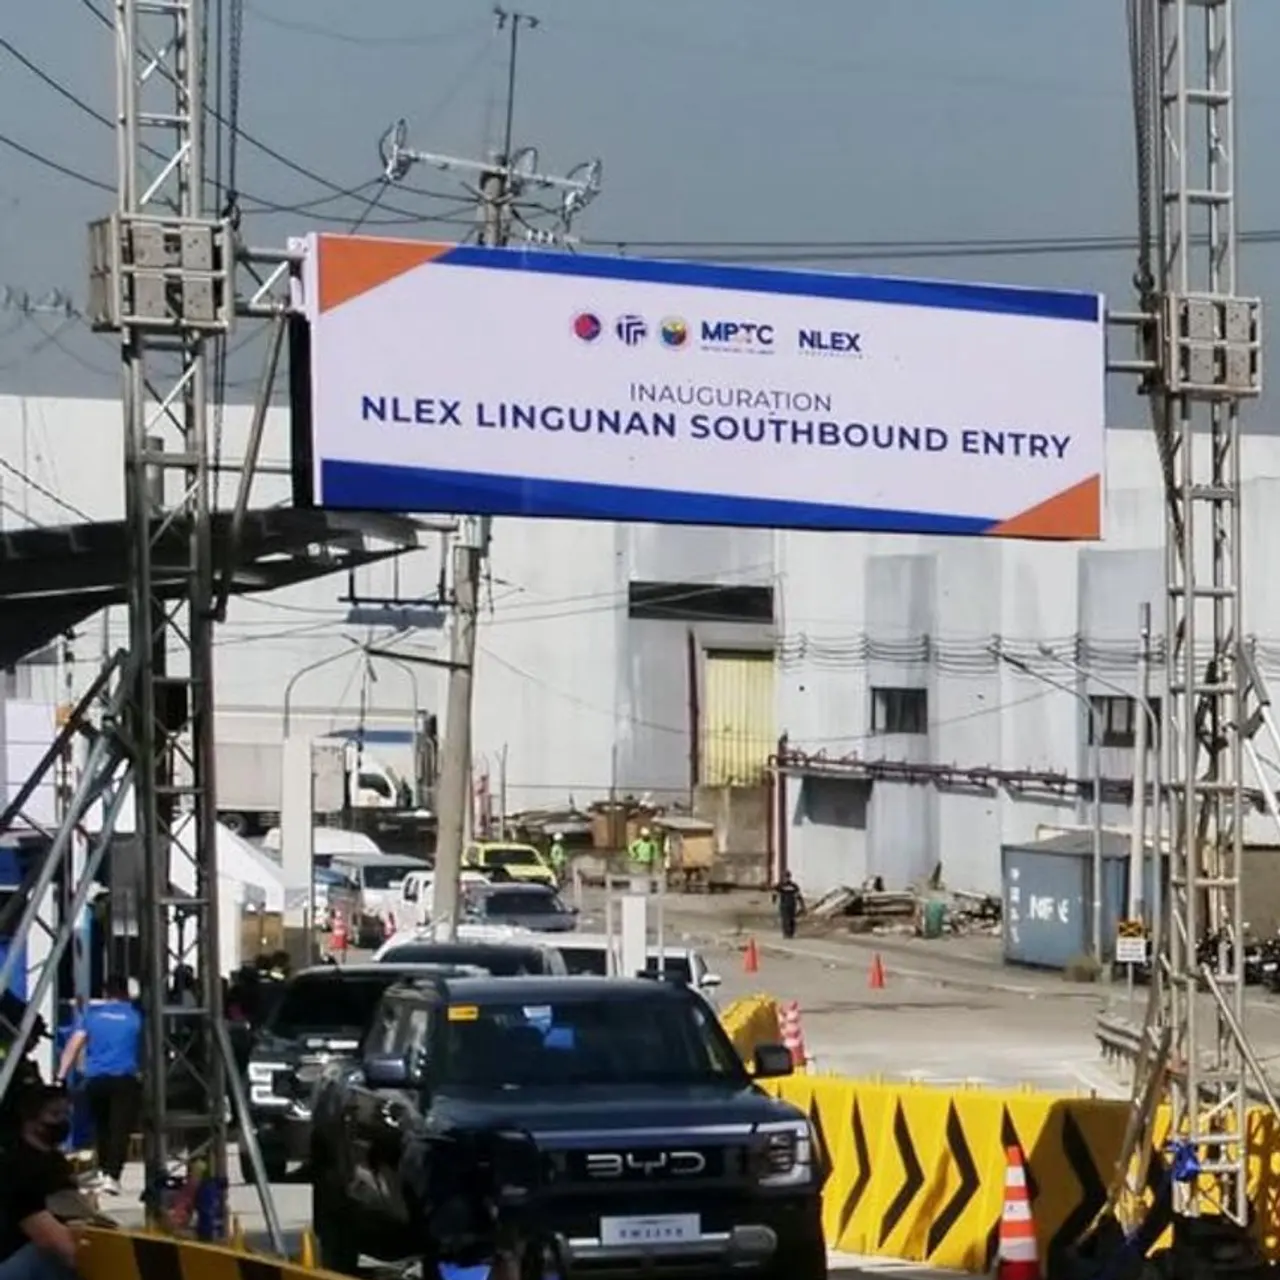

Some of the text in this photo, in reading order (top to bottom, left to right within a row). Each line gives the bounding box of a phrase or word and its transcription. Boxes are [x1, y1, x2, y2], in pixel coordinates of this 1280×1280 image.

[701, 320, 774, 346] MPTC
[798, 329, 861, 352] NLEX
[630, 383, 832, 412] INAUGURATION
[361, 395, 1071, 459] NLEX LINGUNAN SOUTHBOUND ENTRY
[586, 1151, 706, 1177] BYD
